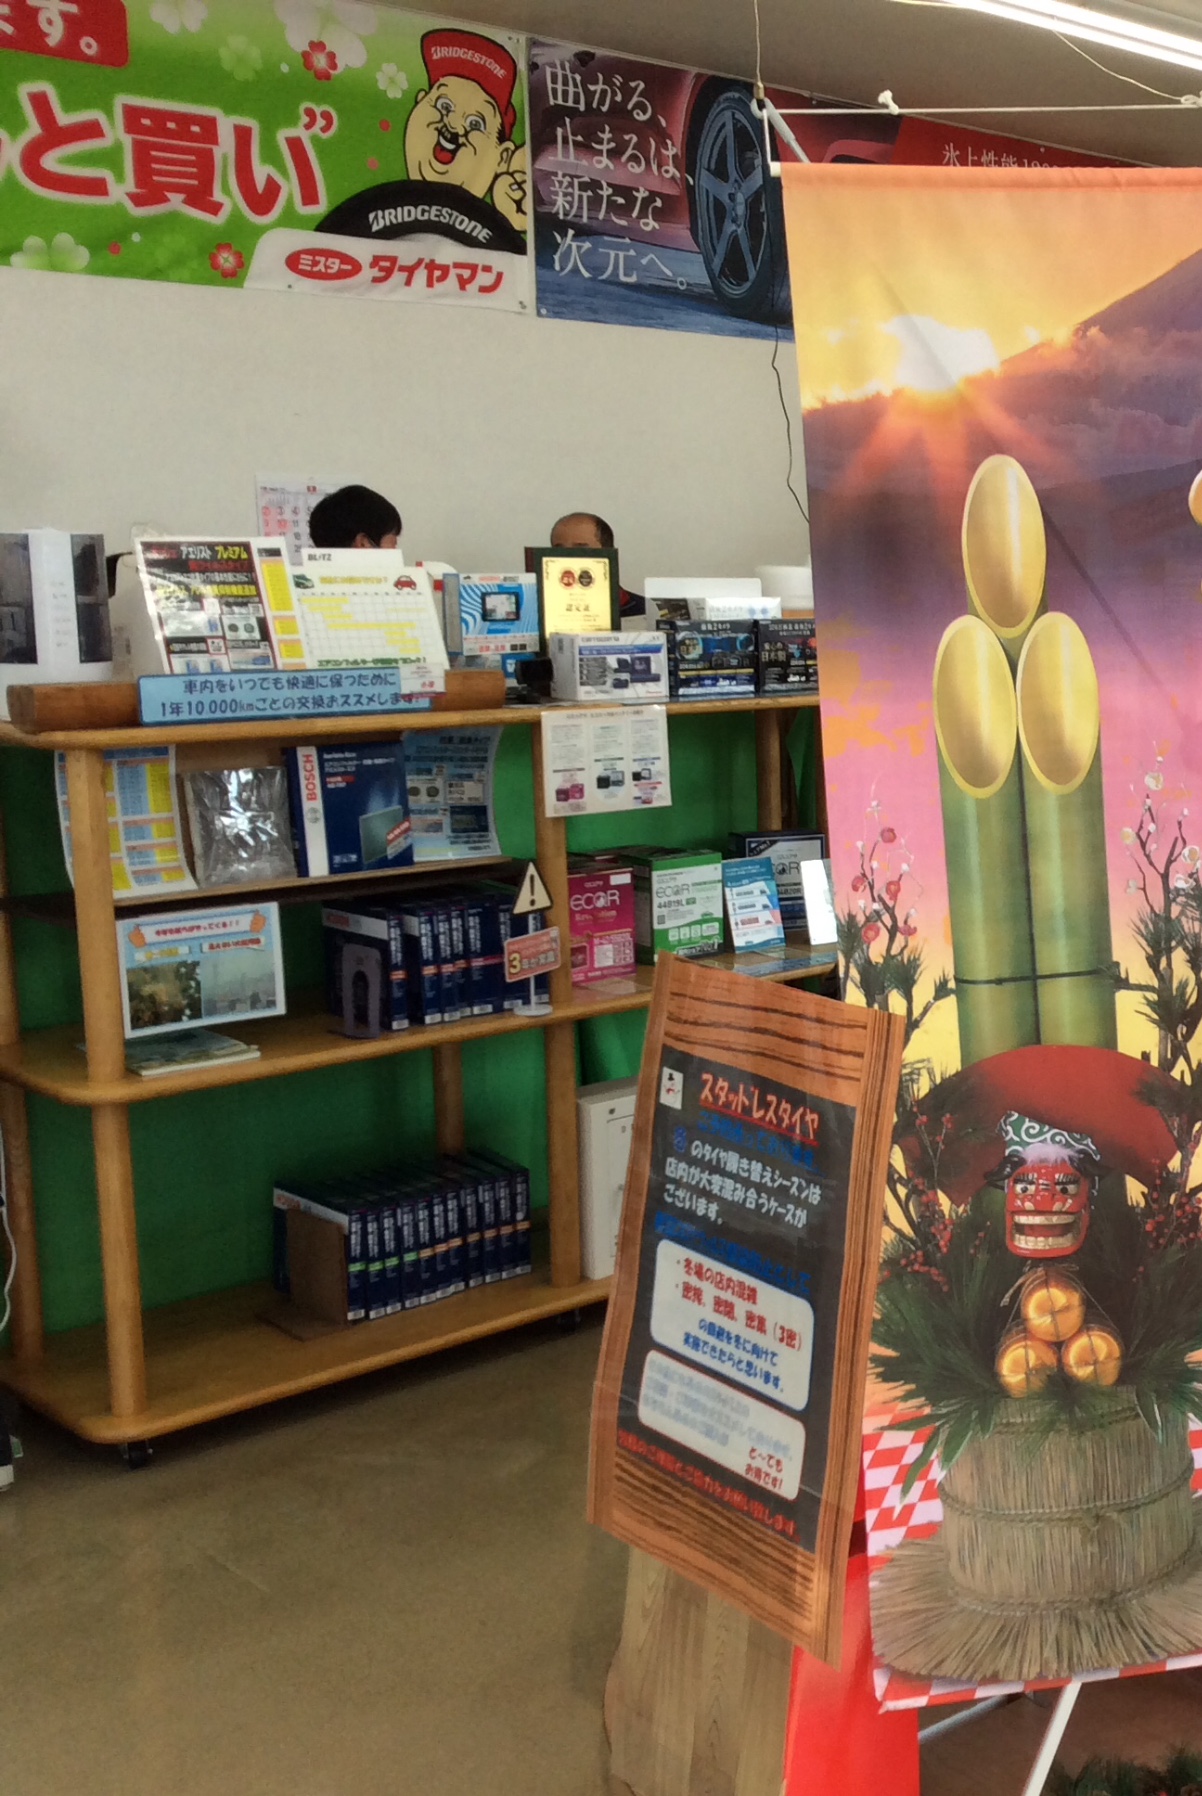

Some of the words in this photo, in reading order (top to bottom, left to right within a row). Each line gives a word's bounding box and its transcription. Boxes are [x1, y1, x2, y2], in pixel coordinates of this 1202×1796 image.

[430, 45, 508, 79] BRIDGESTONE
[545, 60, 669, 127] 曲がる、
[552, 122, 694, 185] 止まるは、
[549, 170, 662, 230] 新たな
[368, 206, 494, 244] BRIDGESTONE
[298, 256, 355, 275] ミスター
[368, 256, 505, 294] タイヤマン
[551, 228, 689, 291] 次元へ。
[183, 671, 397, 695] 車内をいつでも快適に保つために
[302, 753, 318, 802] BOSCH
[700, 1071, 821, 1140] スタッドレスタイヤ
